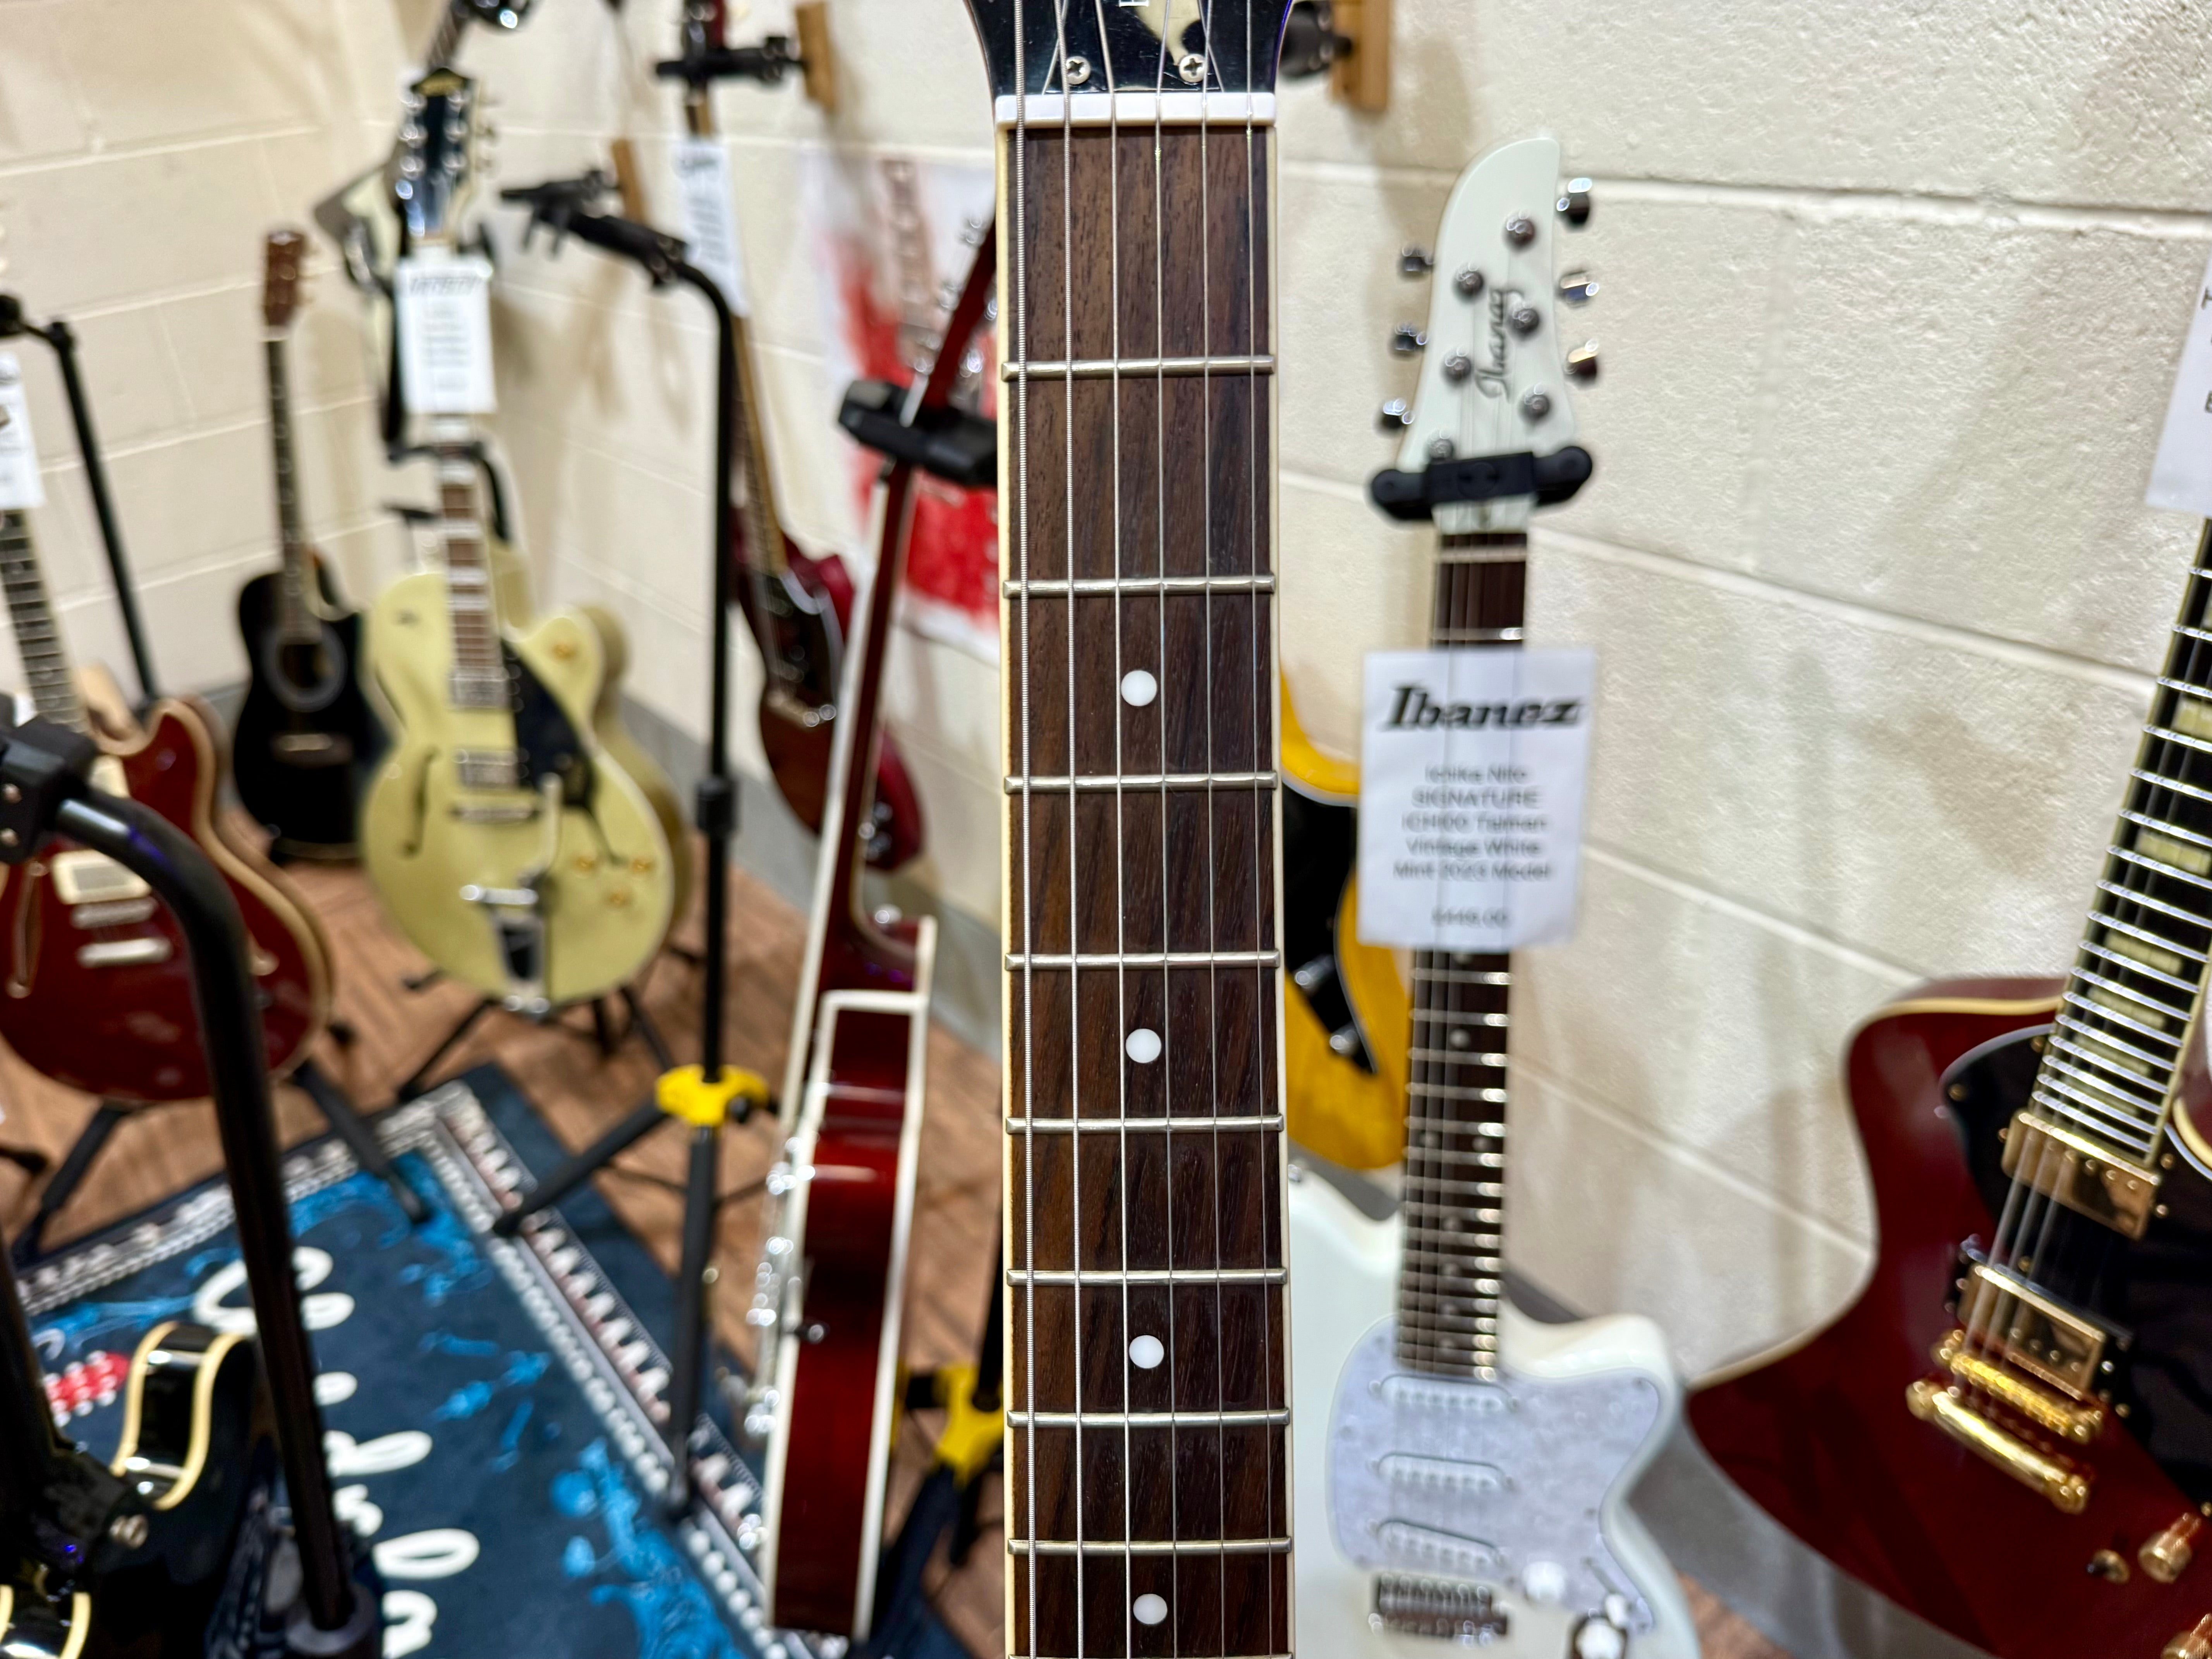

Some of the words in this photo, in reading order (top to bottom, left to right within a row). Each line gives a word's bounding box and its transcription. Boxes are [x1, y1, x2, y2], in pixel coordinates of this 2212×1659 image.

[1475, 288, 1524, 403] Ibanez
[1382, 684, 1583, 731] Ibanez
[1412, 786, 1542, 809] SIGNATURE
[1406, 835, 1482, 859] Vintage
[1484, 836, 1543, 857] White
[1492, 859, 1553, 880] Model
